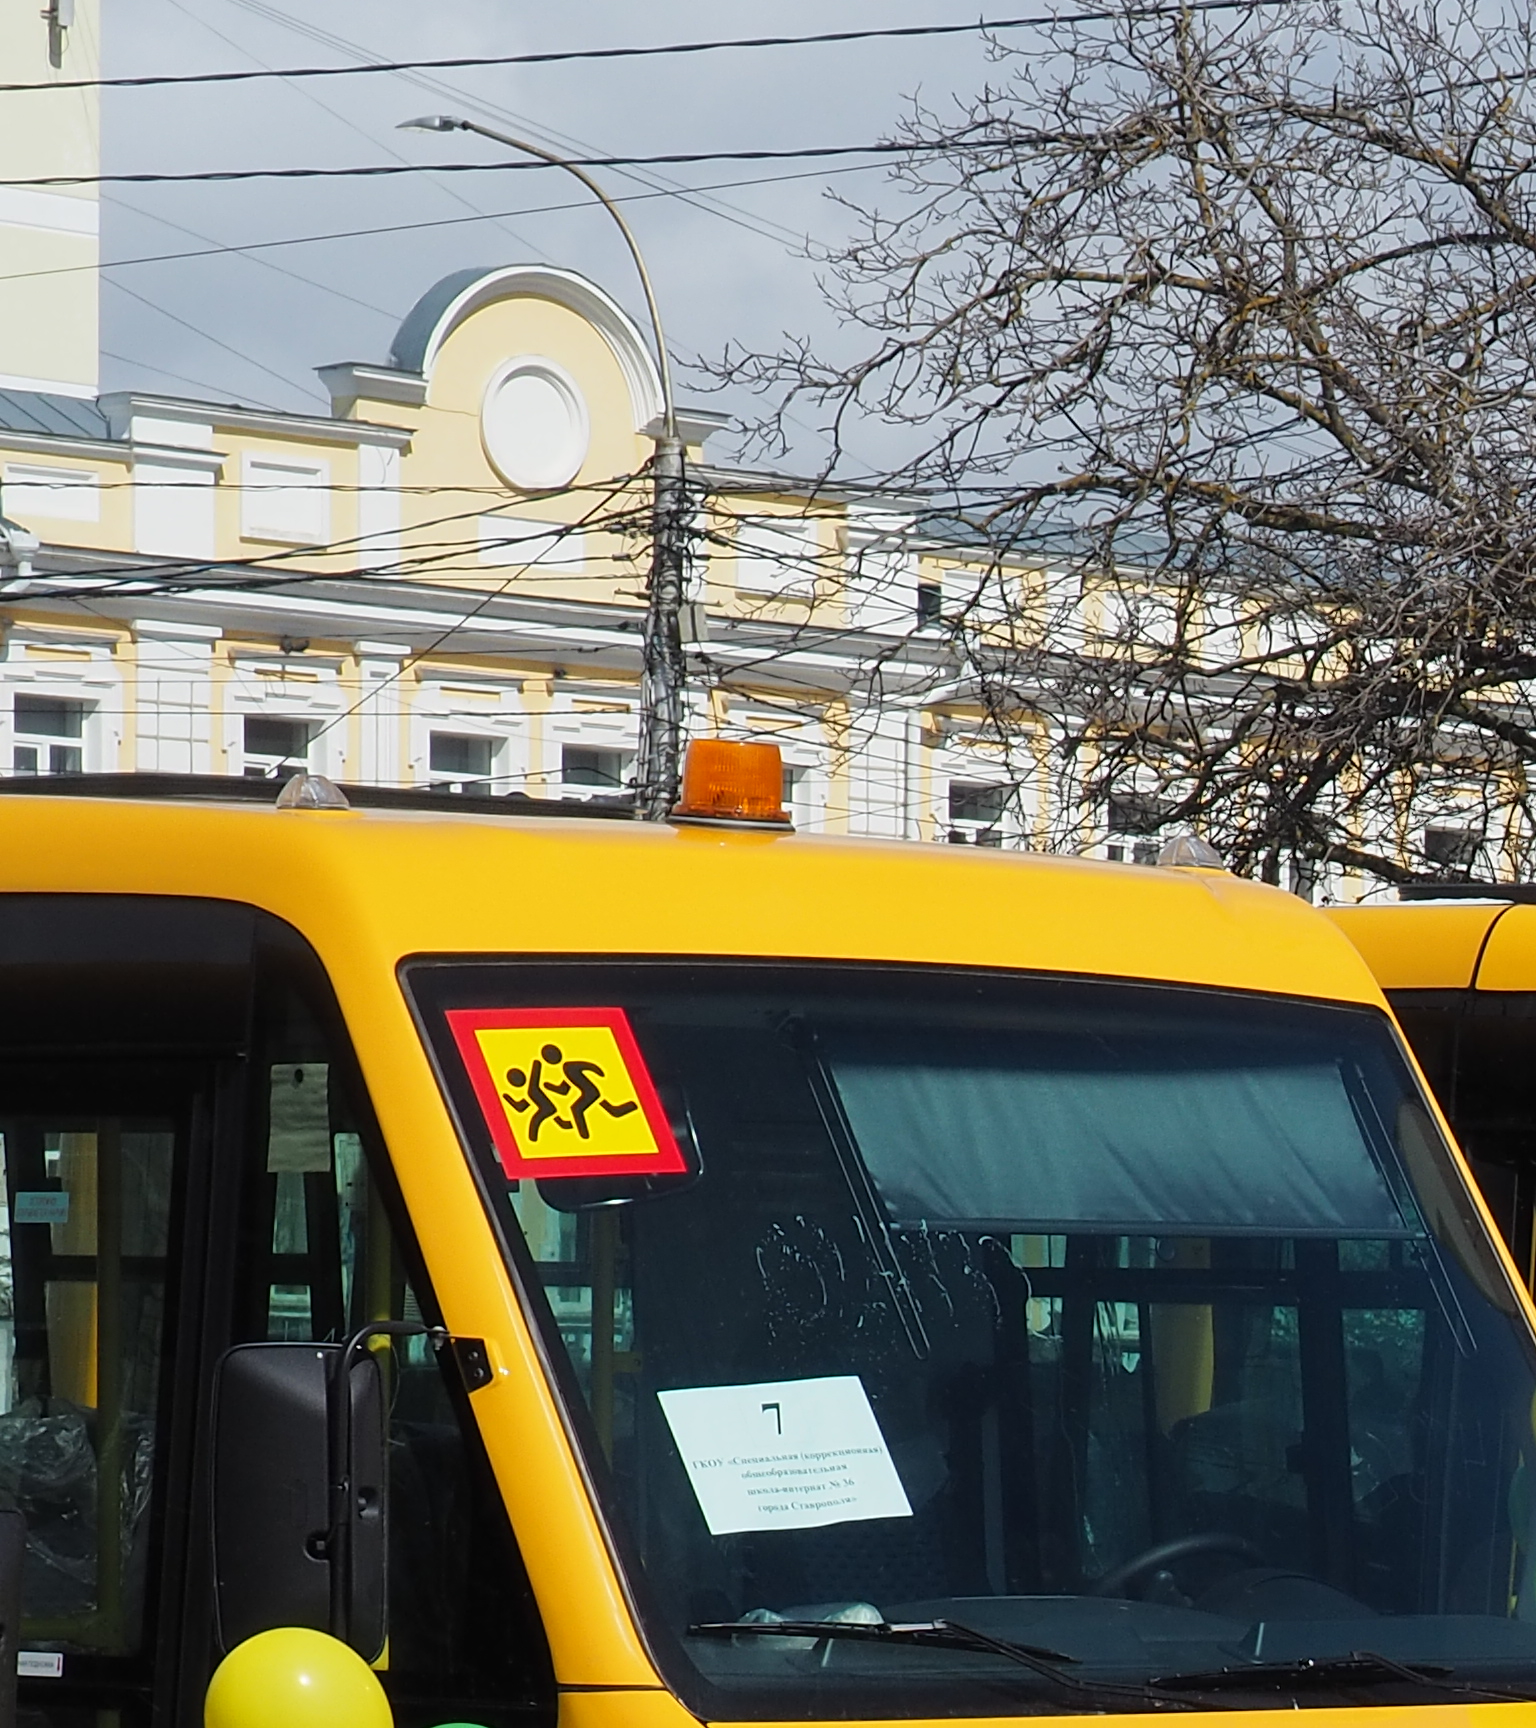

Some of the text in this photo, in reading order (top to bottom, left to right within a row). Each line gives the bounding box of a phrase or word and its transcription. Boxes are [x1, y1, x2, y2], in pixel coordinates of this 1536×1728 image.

[760, 1402, 782, 1435] 7
[692, 1456, 724, 1470] ГКОУ
[758, 1502, 790, 1514] города
